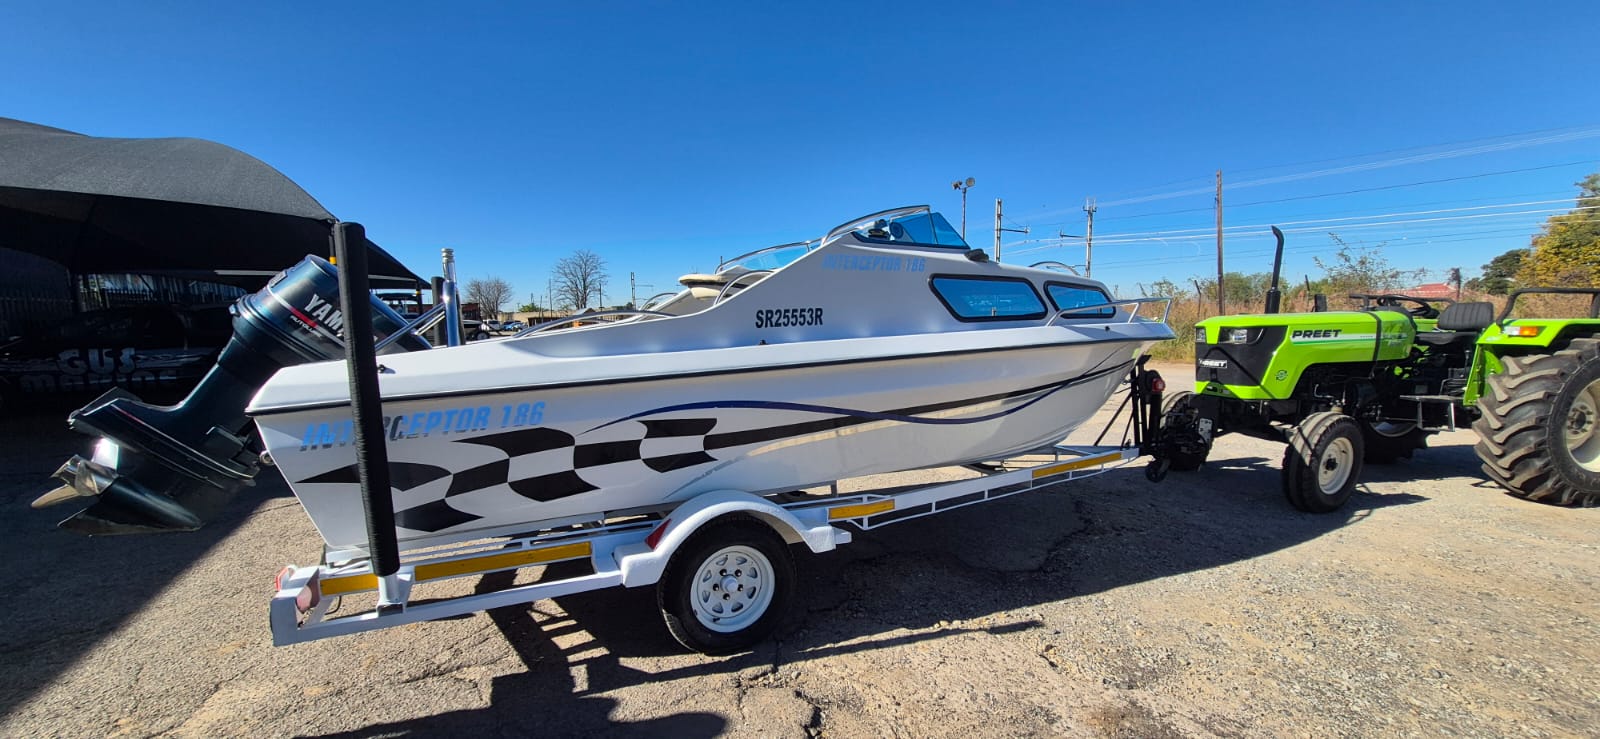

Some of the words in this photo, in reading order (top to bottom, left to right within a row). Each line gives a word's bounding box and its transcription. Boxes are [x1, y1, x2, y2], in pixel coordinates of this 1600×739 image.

[822, 253, 901, 271] INTERCEPTOR
[905, 256, 926, 272] 186
[755, 307, 823, 328] SR25553R
[1291, 329, 1342, 338] PREET
[57, 347, 136, 375] GUS
[300, 406, 491, 451] INTCEPTOR
[501, 401, 545, 428] 186
